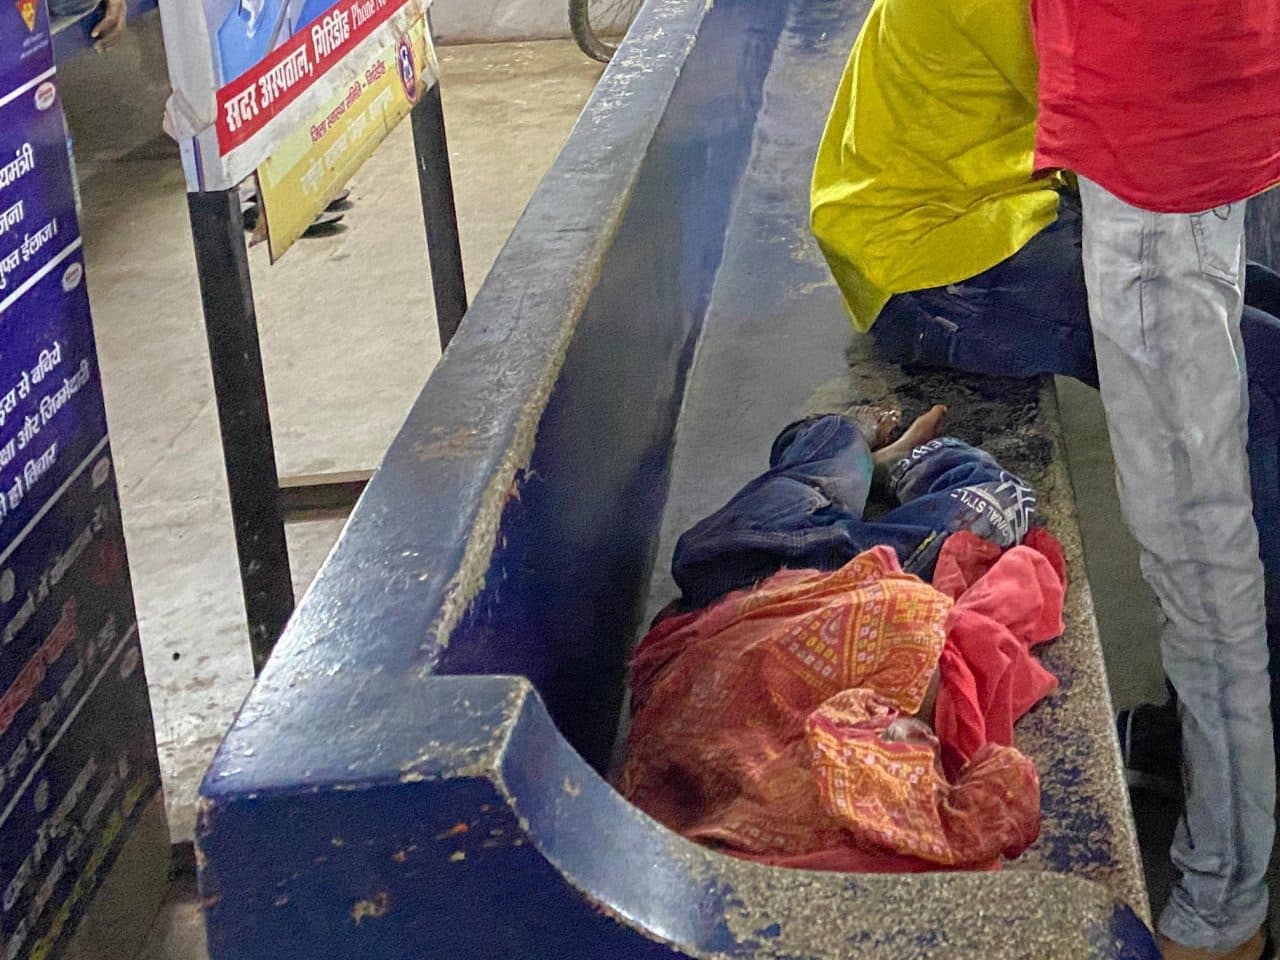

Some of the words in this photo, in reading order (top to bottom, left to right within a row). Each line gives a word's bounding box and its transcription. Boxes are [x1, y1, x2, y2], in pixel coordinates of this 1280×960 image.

[224, 83, 259, 132] सदर
[311, 10, 350, 64] गिरिडीह
[17, 370, 31, 401] से
[17, 415, 41, 451] और
